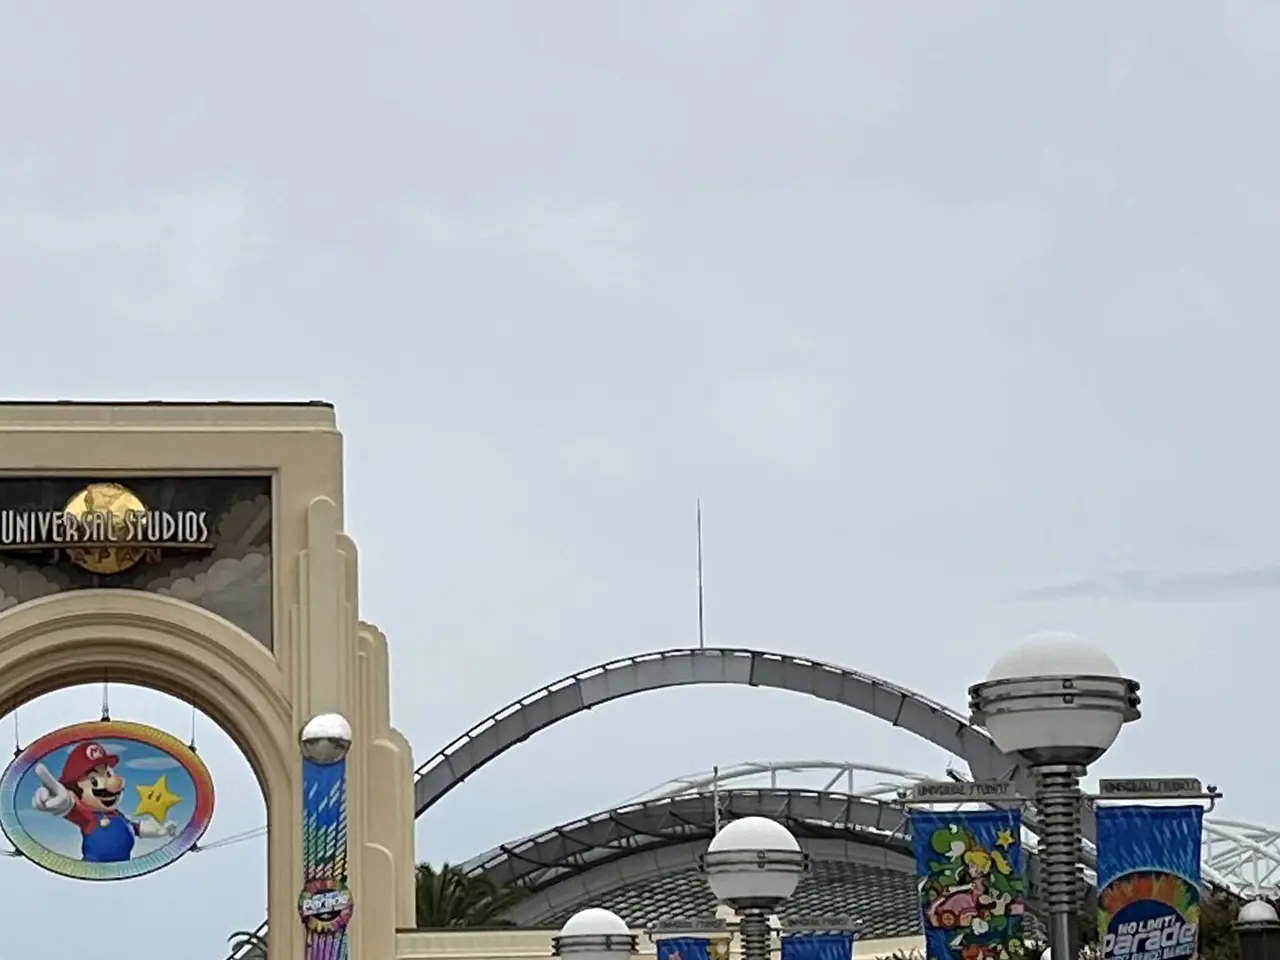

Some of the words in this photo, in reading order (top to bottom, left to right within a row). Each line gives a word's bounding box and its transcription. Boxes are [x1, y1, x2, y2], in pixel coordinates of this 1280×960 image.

[1, 509, 119, 544] UNIVERSAL
[126, 509, 209, 543] STUDIOS
[50, 548, 162, 564] JAPAN
[1118, 921, 1137, 934] NO
